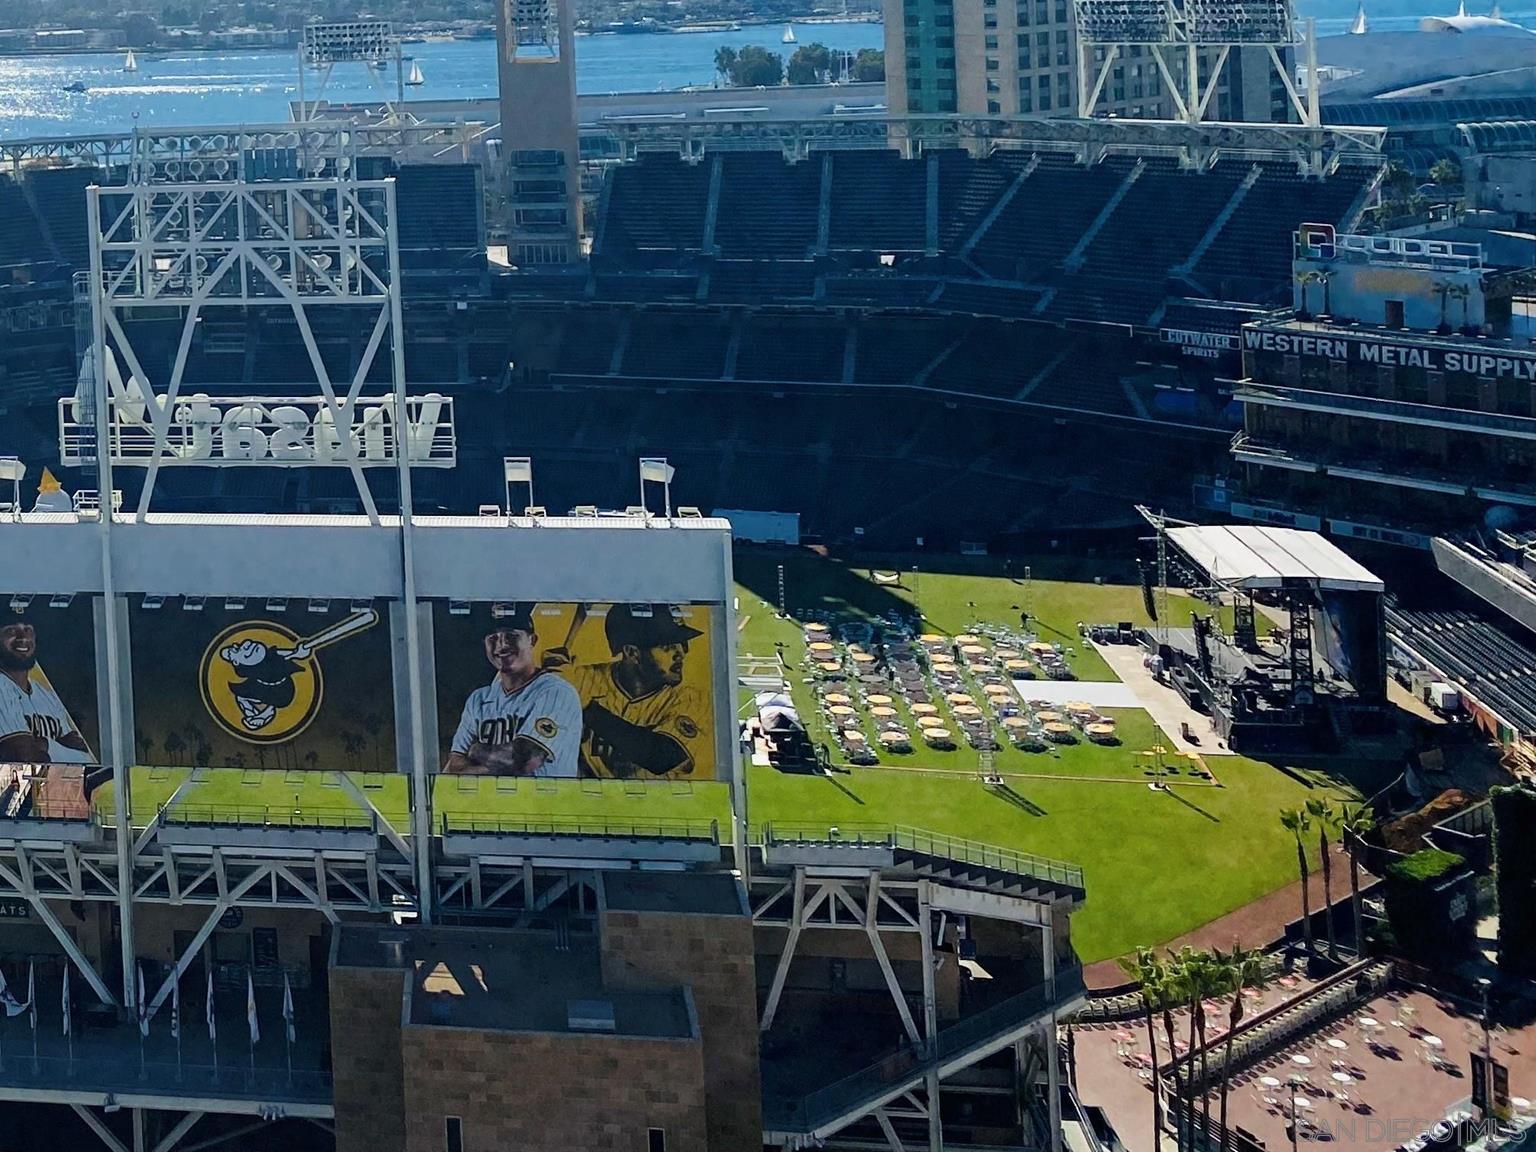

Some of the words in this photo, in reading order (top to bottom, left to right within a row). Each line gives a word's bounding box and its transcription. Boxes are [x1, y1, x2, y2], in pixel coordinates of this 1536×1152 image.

[1181, 345, 1220, 359] SPIRITS
[1245, 330, 1348, 359] WESTERN
[1360, 342, 1438, 370] METAL
[1444, 351, 1536, 381] SUPPLY
